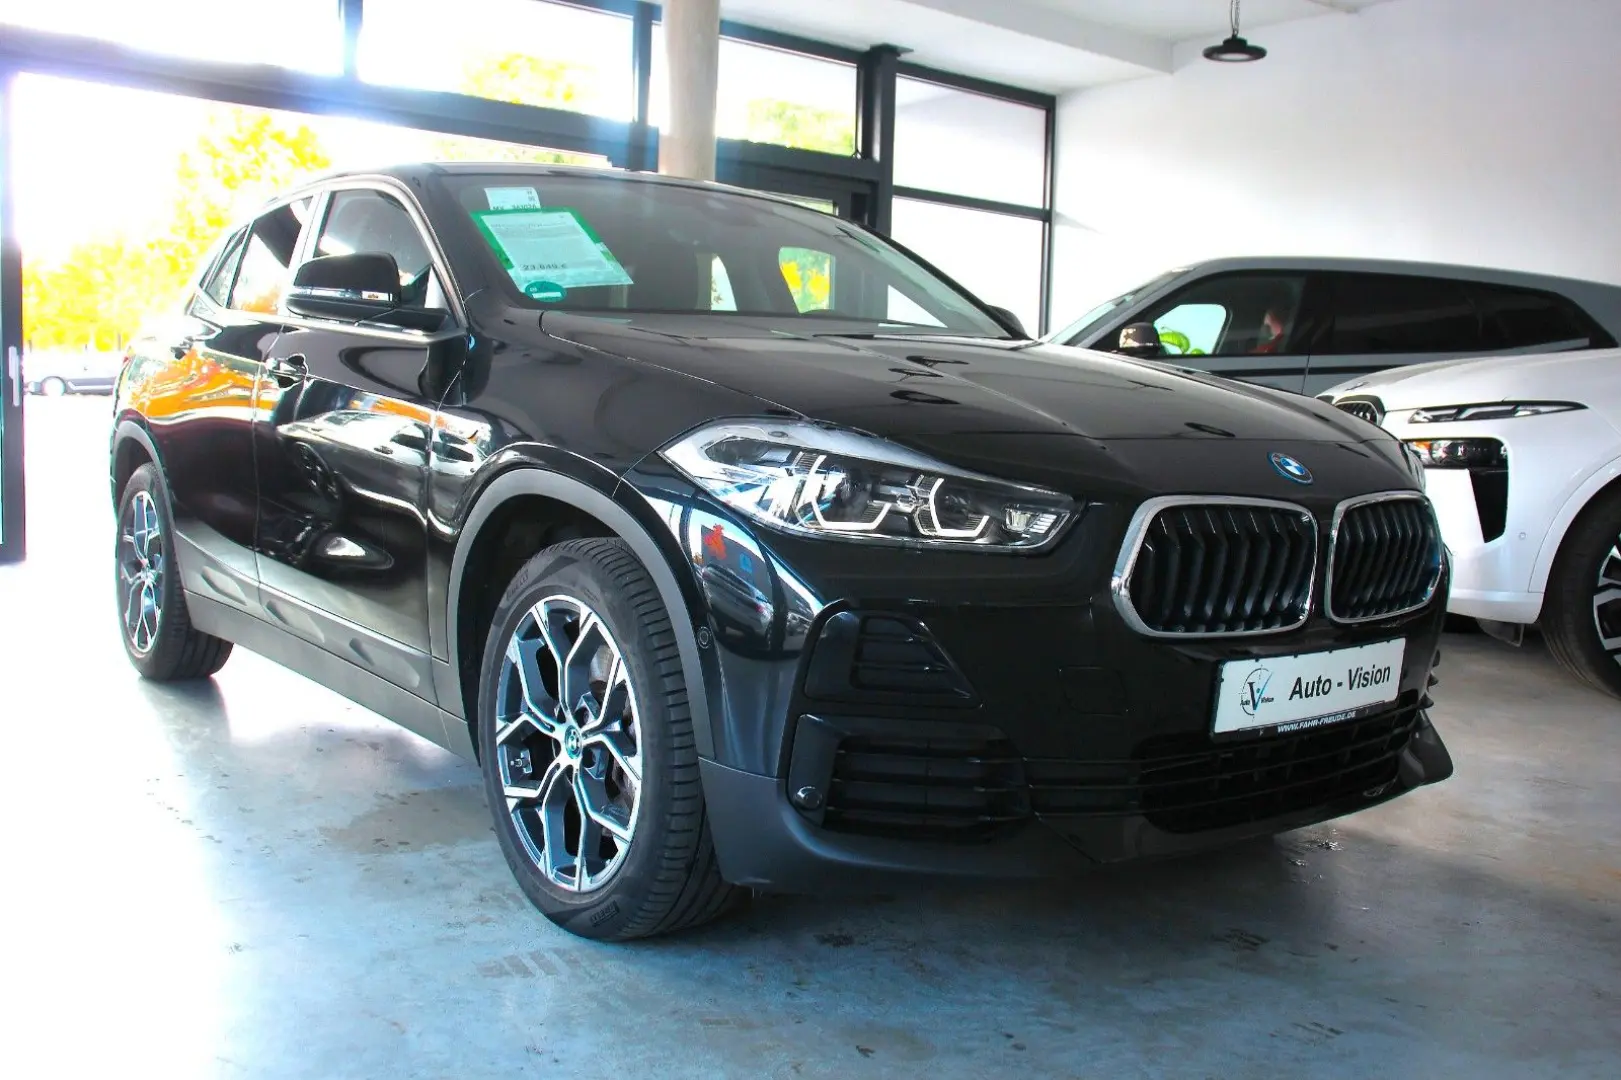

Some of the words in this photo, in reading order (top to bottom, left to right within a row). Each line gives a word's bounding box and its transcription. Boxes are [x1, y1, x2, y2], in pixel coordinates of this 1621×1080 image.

[1289, 677, 1332, 700] Auto
[1348, 664, 1391, 690] Vision
[1277, 710, 1357, 733] WWW.FAHR-FREUDE.DE
